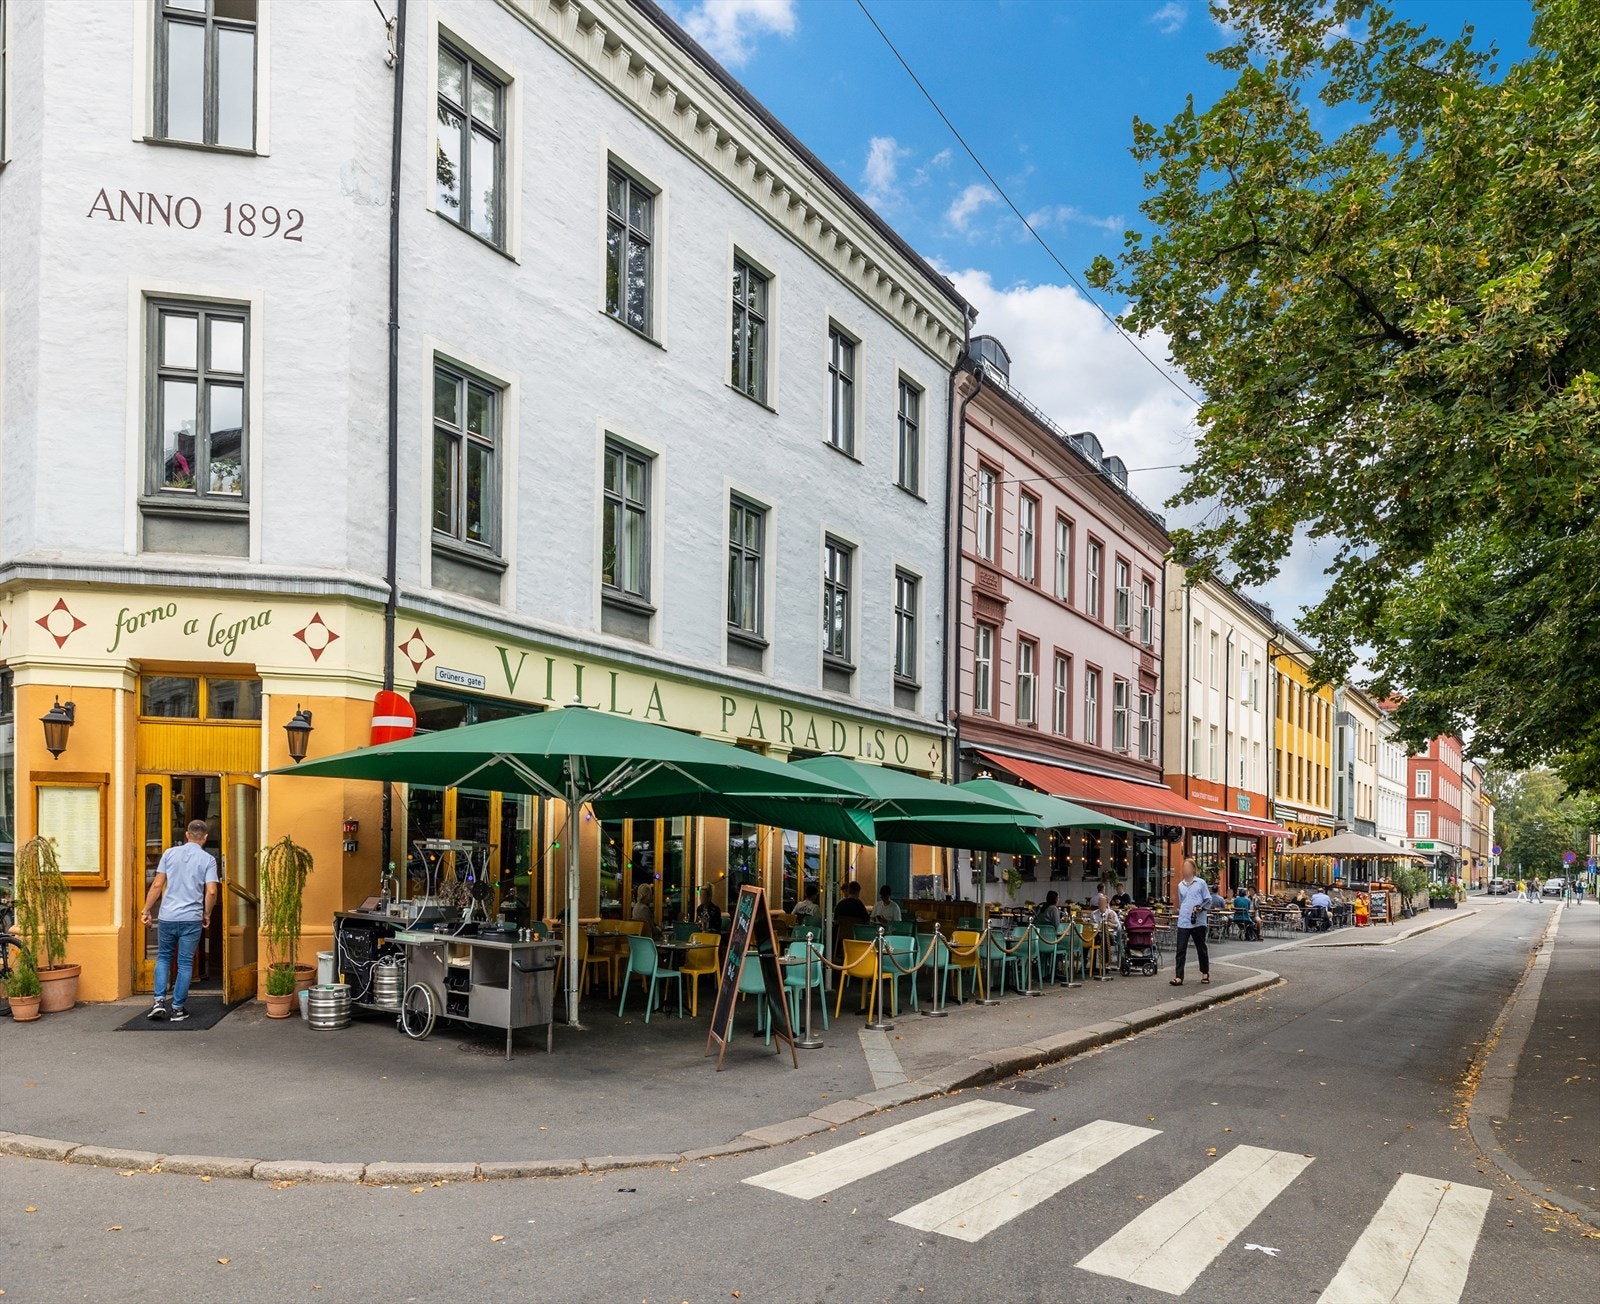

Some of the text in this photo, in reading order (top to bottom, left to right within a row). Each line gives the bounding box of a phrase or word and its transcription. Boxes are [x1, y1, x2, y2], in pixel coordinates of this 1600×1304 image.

[86, 187, 304, 242] ANNO 1892
[106, 602, 272, 657] forno a legna
[439, 670, 482, 686] Grüners gate
[495, 645, 909, 764] VILLA PARADISO
